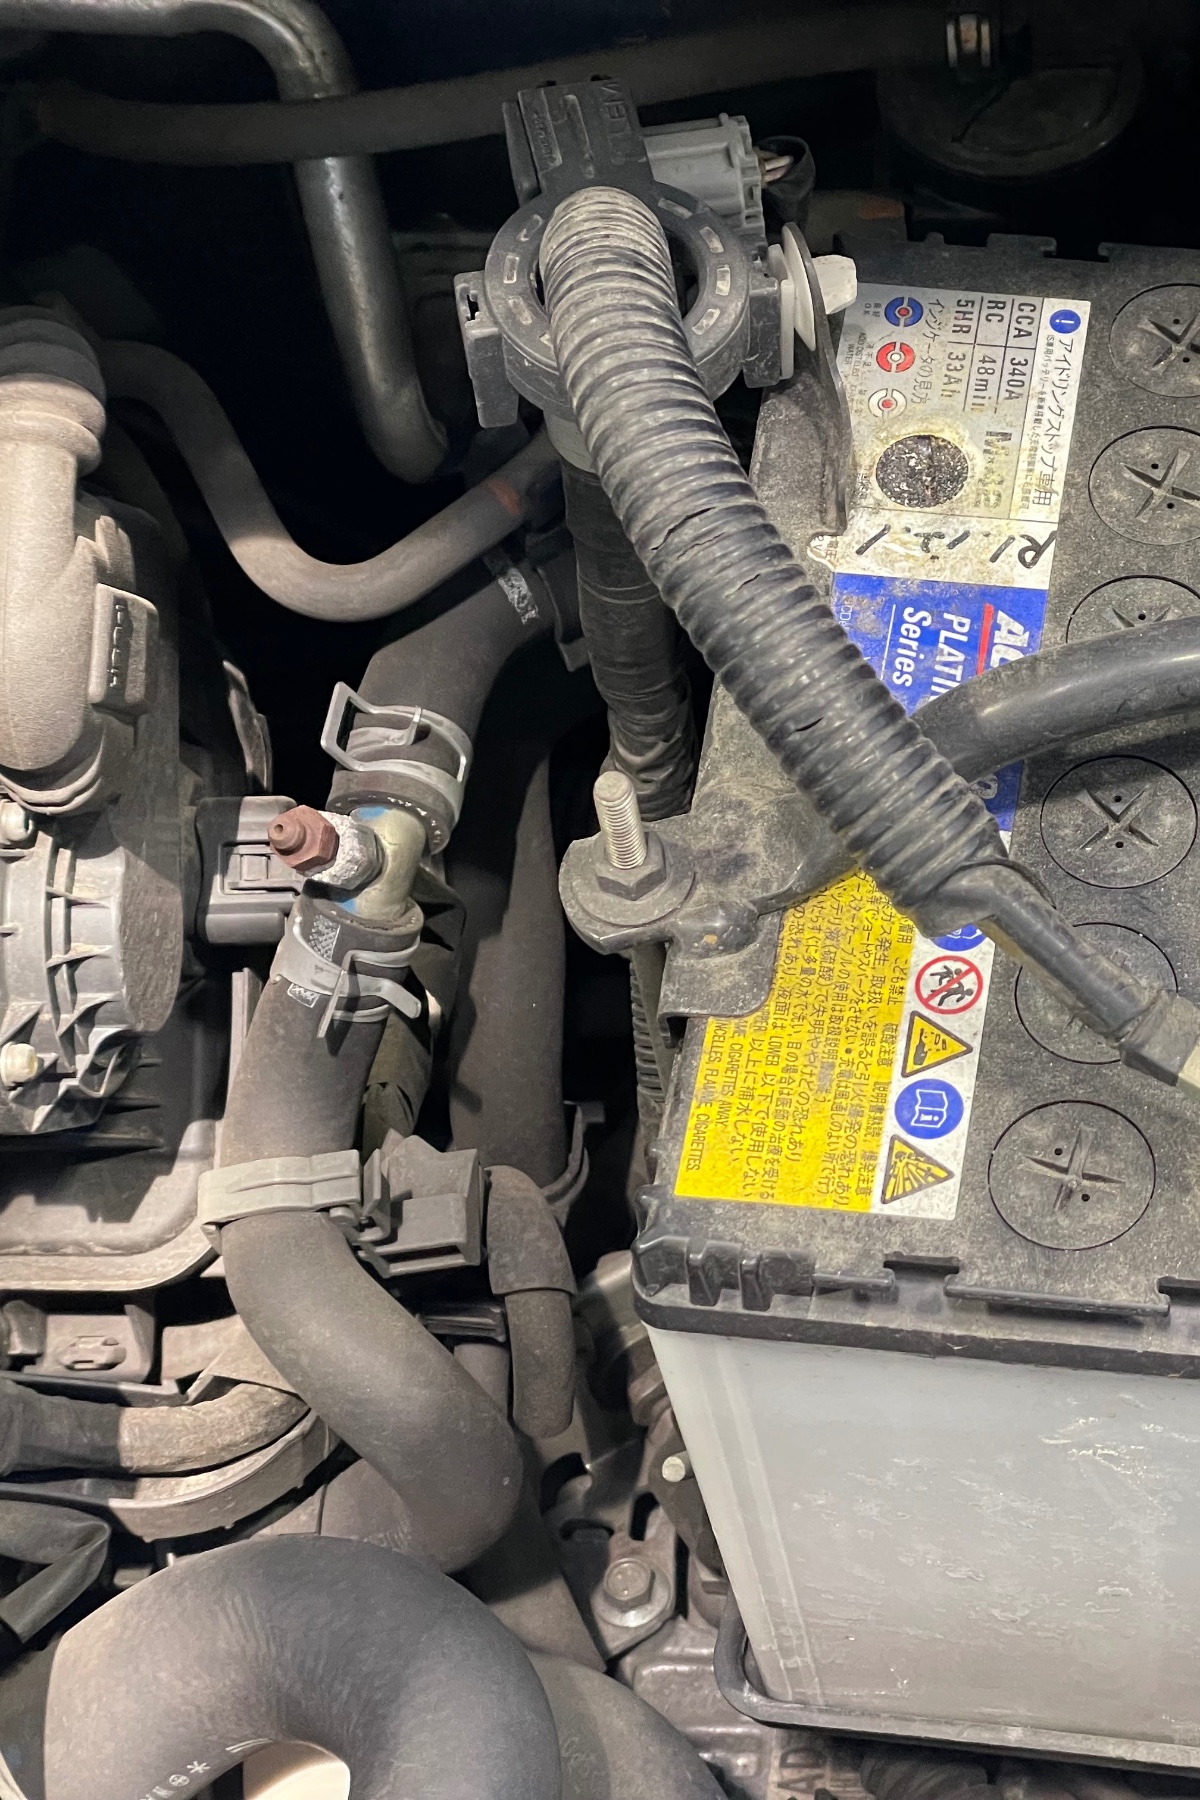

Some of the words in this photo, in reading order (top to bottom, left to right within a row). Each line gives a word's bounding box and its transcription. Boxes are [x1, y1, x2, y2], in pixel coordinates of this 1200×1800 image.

[951, 298, 976, 335] 5HR
[985, 300, 1007, 323] RC
[1012, 302, 1038, 339] CCA
[910, 299, 945, 405] インジケータの見方
[1004, 357, 1029, 401] 340A
[1032, 338, 1075, 506] アイドリングストップ車用
[892, 606, 932, 688] Series
[898, 912, 916, 944] 着用
[886, 956, 910, 1006] こども禁止
[725, 1040, 745, 1098] CIGARETTES
[768, 1035, 783, 1068] LOWER
[714, 1100, 734, 1128] AWAY.
[731, 1037, 767, 1163] 以上に補水しない
[685, 1112, 711, 1172] CIGARETTES.
[742, 1071, 778, 1198] 以下で使用しない
